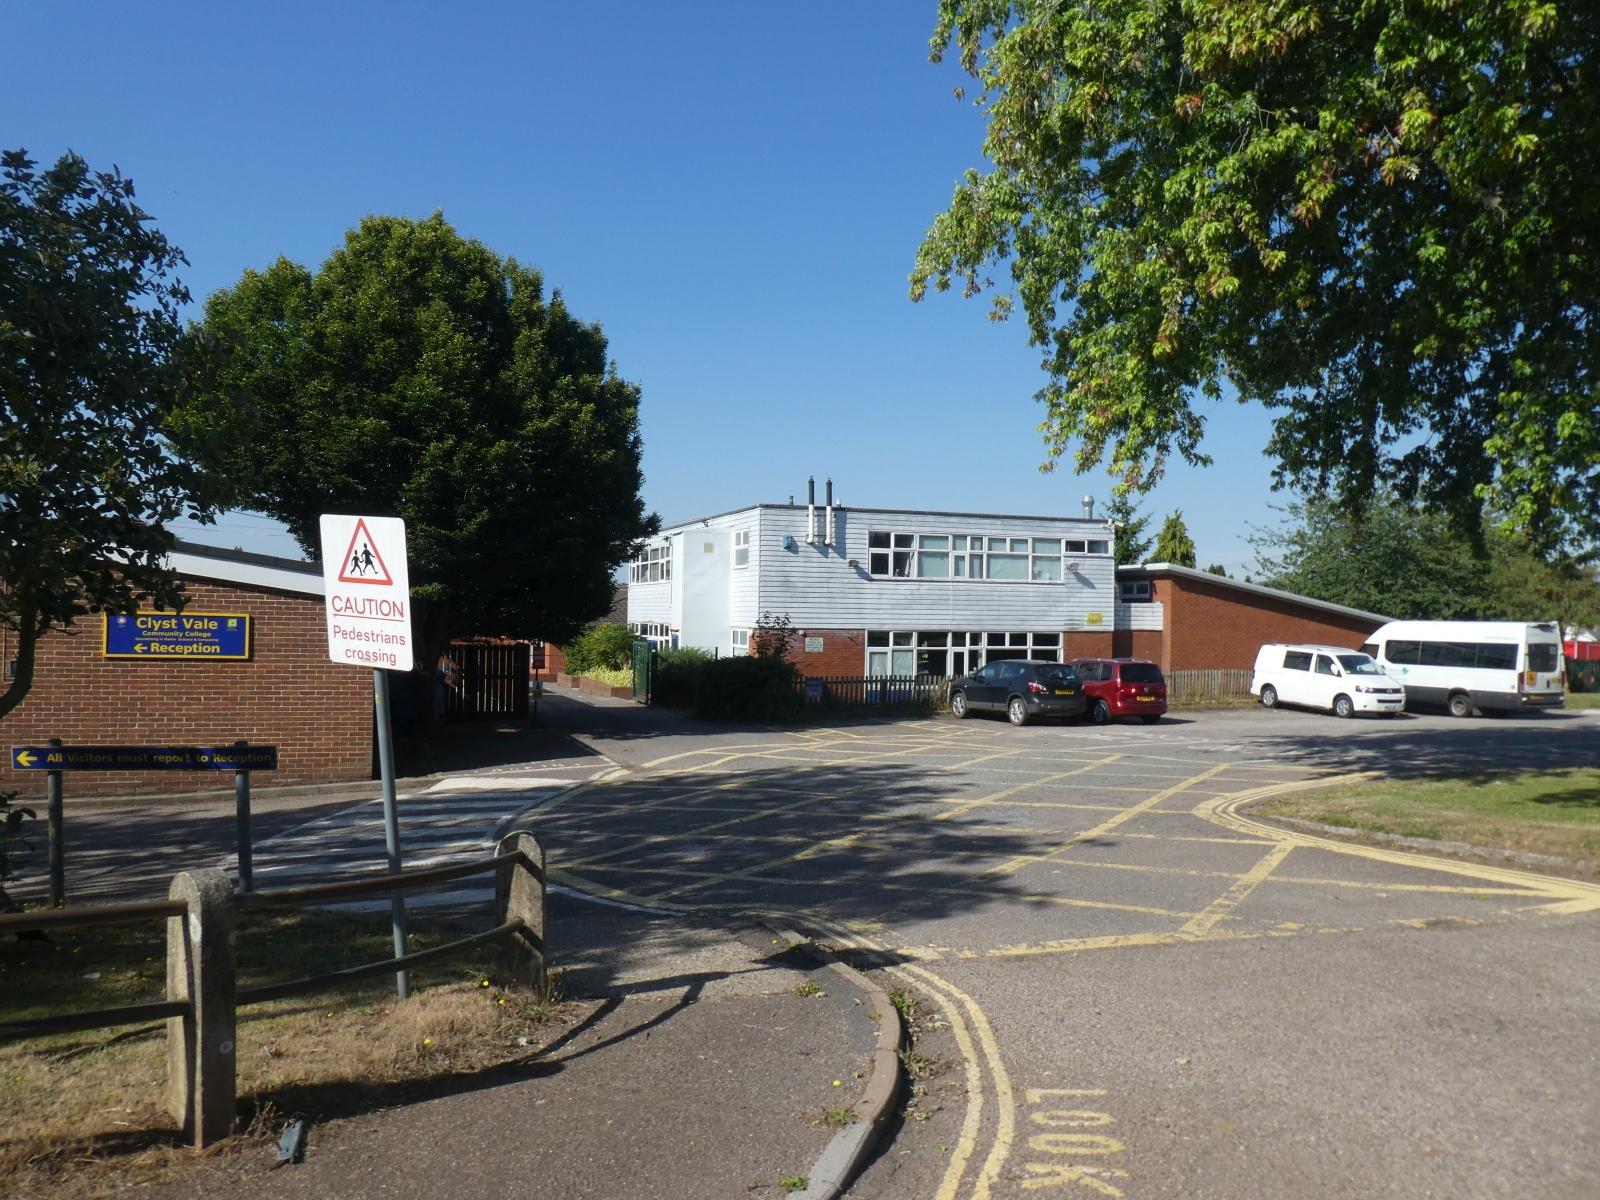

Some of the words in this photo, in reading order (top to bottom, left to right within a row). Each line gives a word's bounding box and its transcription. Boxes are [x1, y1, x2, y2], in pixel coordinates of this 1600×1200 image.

[332, 595, 404, 618] CAUTION
[136, 617, 178, 631] Clyst
[182, 618, 218, 630] Vale
[142, 630, 184, 638] Community
[185, 631, 212, 639] College
[333, 624, 406, 646] Pedestrians
[151, 643, 220, 655] Reception
[345, 648, 397, 667] crossing
[46, 753, 63, 763] All
[68, 753, 113, 764] Visitors
[118, 754, 149, 764] must
[153, 754, 191, 766] report
[196, 754, 209, 764] to
[212, 752, 273, 766] Reception
[1021, 1088, 1129, 1197] LOOK
